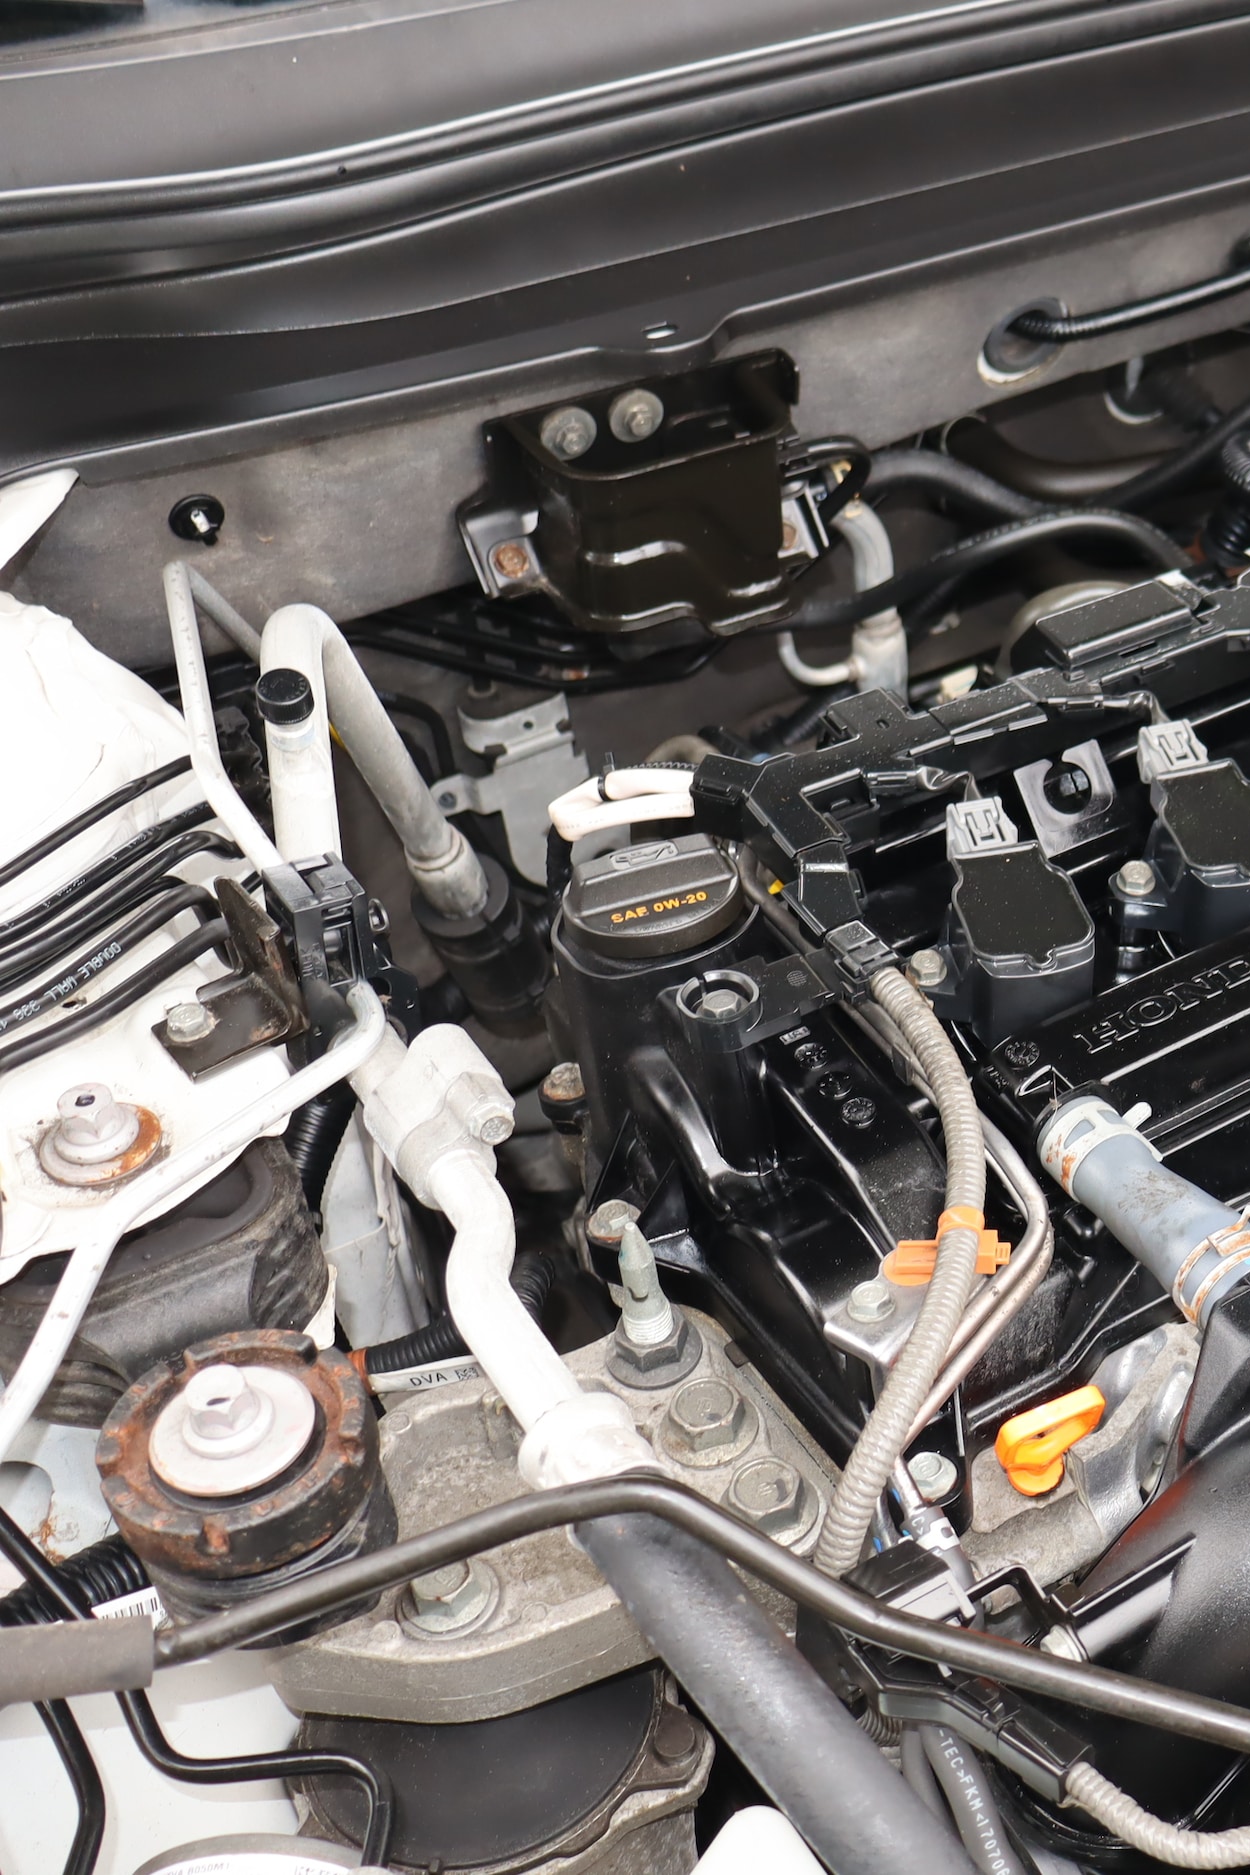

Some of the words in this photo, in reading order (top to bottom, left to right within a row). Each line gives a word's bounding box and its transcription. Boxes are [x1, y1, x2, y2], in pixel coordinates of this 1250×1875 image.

[610, 906, 650, 924] SAE
[653, 891, 708, 913] 0W-20
[77, 941, 122, 979] DOUBLE
[43, 975, 78, 1001] WALL
[409, 1372, 448, 1387] DVA
